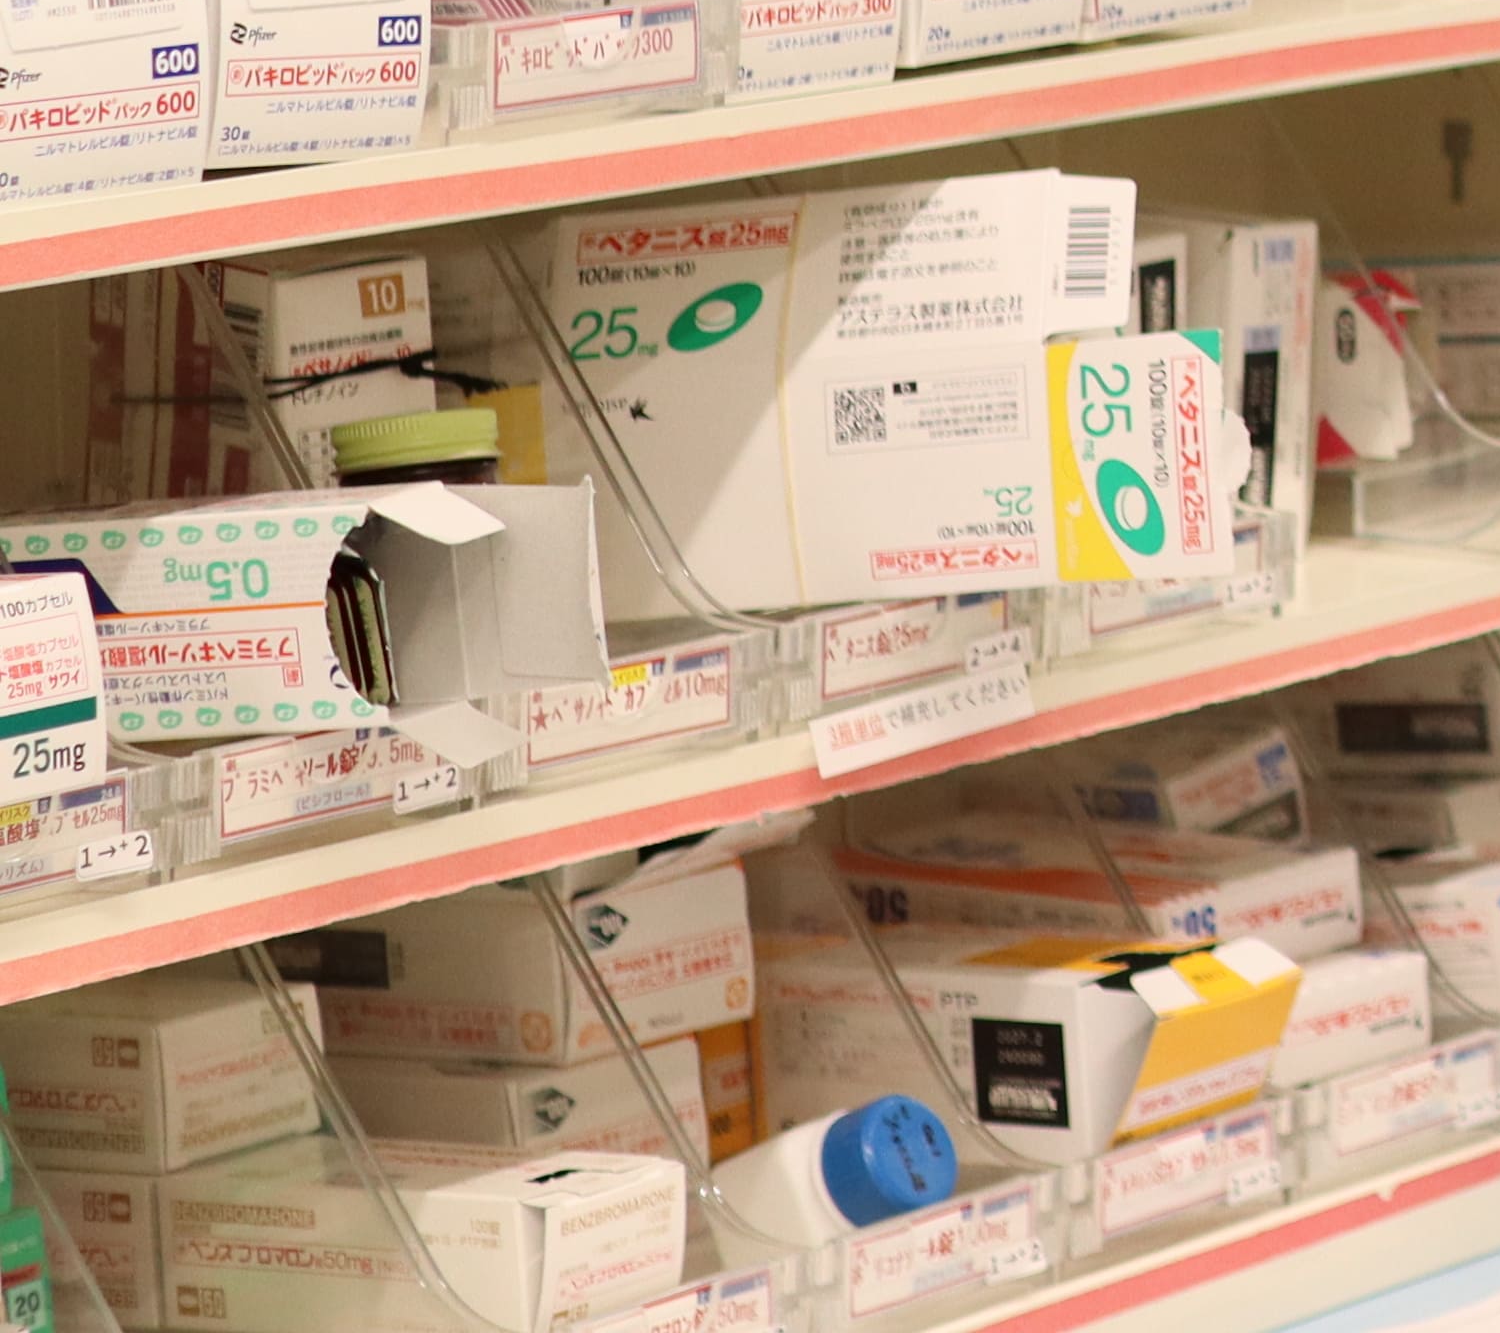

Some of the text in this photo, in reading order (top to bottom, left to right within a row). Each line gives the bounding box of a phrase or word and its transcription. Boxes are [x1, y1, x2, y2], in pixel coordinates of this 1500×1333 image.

[380, 19, 420, 44] 600
[153, 47, 198, 76] 600
[379, 59, 417, 84] 600
[155, 90, 197, 116] 600
[366, 279, 398, 314] 10
[162, 557, 271, 601] 0.5mg
[7, 679, 43, 700] 25mg
[13, 736, 87, 780] 25mg
[14, 1290, 40, 1317] 20
